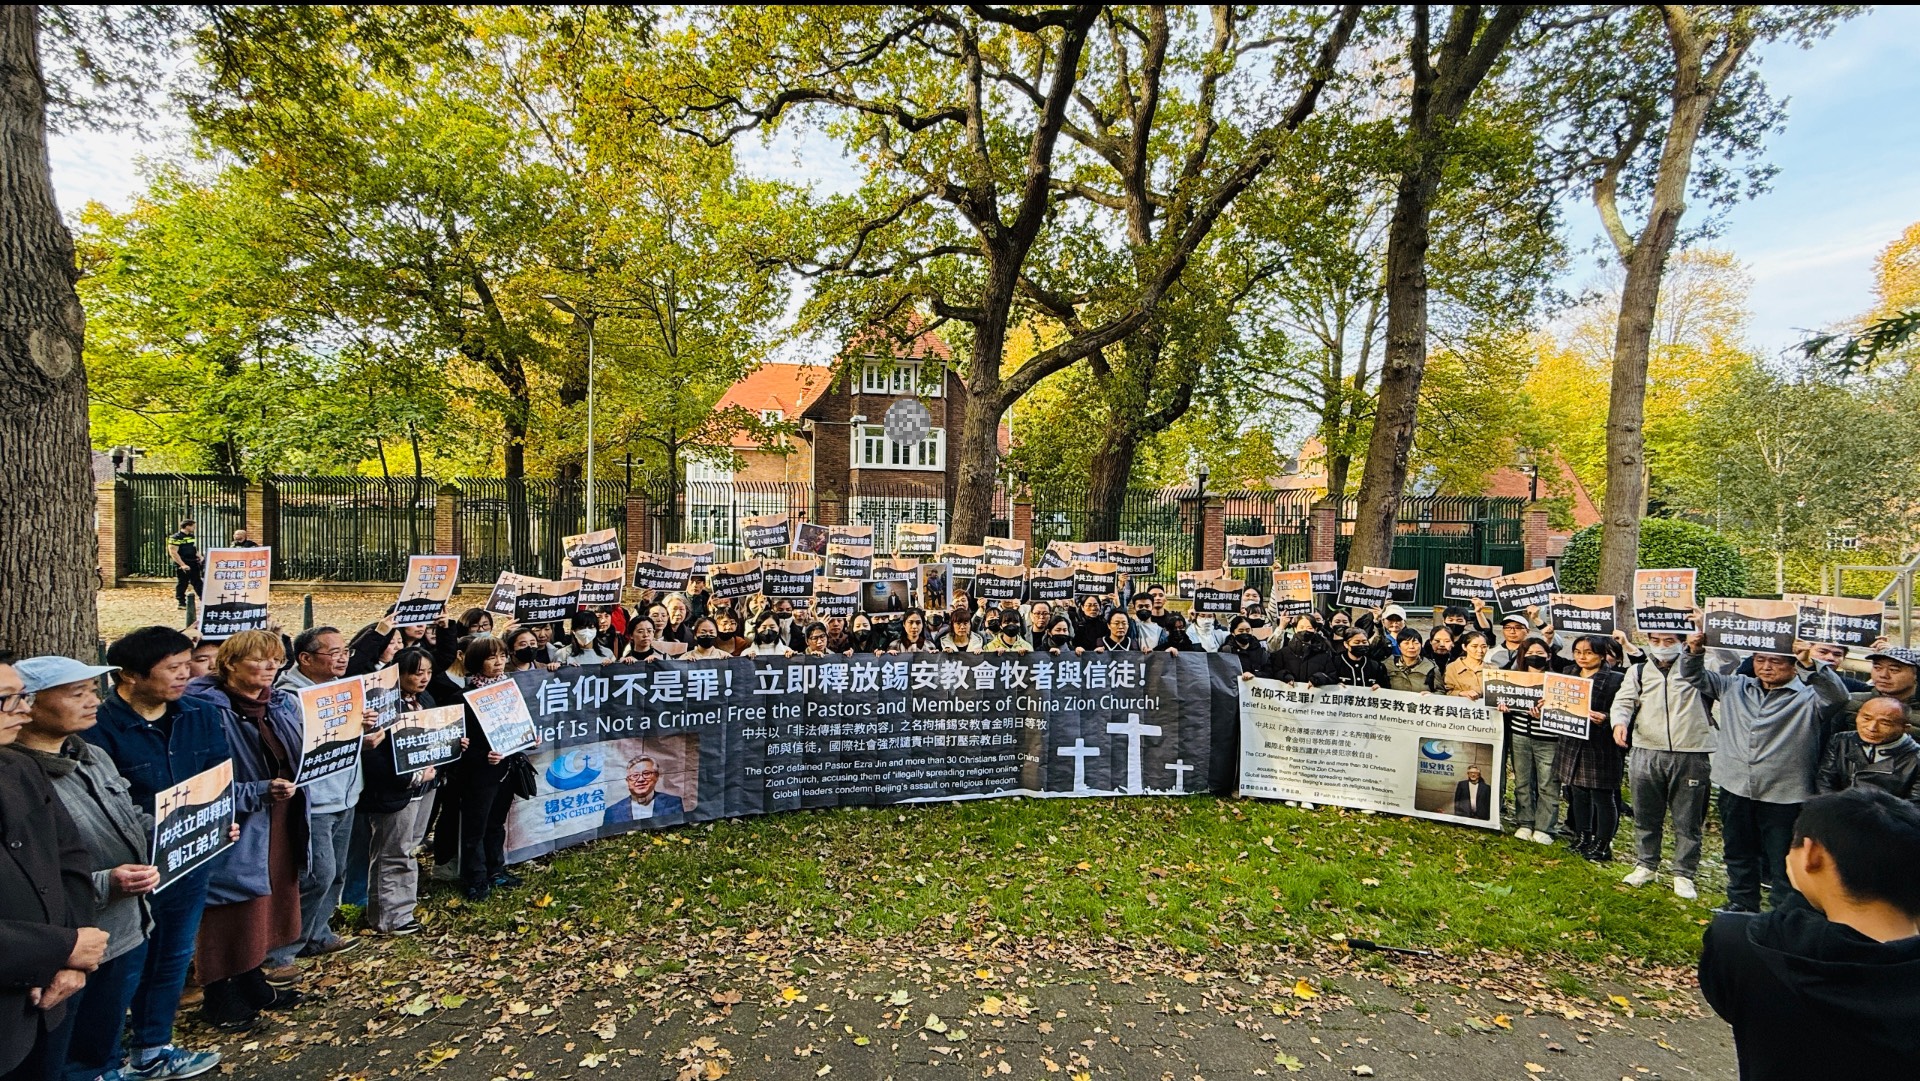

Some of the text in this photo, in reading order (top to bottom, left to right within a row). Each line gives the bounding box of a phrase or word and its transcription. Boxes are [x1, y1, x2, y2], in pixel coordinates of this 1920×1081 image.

[744, 526, 787, 537] 中共立即釋放
[569, 542, 617, 558] 中共立即釋放
[986, 548, 1022, 558] 中共立即釋放
[1229, 548, 1272, 556] 中共立即釋放
[829, 557, 870, 567] 中共立即釋放
[1110, 555, 1152, 564] 中共立即釋放
[639, 567, 689, 579] 中共立即釋放
[713, 572, 760, 587] 中共立即釋放
[765, 574, 812, 583] 中共立即釋放
[978, 578, 1021, 587] 中共立即釋放
[1033, 580, 1073, 589] 中共立即釋放
[772, 586, 804, 594] 王林牧師
[1197, 592, 1240, 600] 中共立即釋放
[1343, 585, 1386, 597] 中共立即釋放
[1499, 582, 1555, 599] 中共立即釋放
[519, 596, 576, 608] 中共立即釋放
[206, 608, 266, 620] 中共立即釋放
[1554, 609, 1611, 620] 中共立即釋放
[1708, 617, 1792, 634] 中共立即釋放
[1800, 613, 1878, 630] 共立即釋放
[1720, 633, 1776, 649] 戰歌傳道
[1487, 684, 1543, 698] 中共立即釋放
[570, 721, 588, 737] Is
[596, 716, 633, 734] Not
[640, 716, 651, 730] a
[658, 708, 721, 729] Crime!
[728, 705, 766, 722] Free
[772, 702, 800, 719] the
[807, 701, 871, 717] Pastors
[876, 697, 906, 714] and
[912, 696, 990, 713] Members
[996, 696, 1012, 711] of
[1016, 696, 1060, 712] China
[1064, 696, 1096, 711] Zion
[1100, 694, 1160, 710] Church!
[1242, 701, 1259, 709] Belief
[1269, 704, 1280, 712] Not
[1364, 712, 1377, 720] and
[1380, 715, 1414, 725] Members
[1426, 721, 1447, 729] China
[1449, 723, 1465, 731] Zion
[1467, 725, 1496, 734] Church!
[1544, 712, 1586, 726] 中共立即釋放
[396, 726, 464, 750] 中共立即釋放
[304, 742, 358, 767] 中共立即釋放
[408, 745, 452, 765] 戰歌傳道
[745, 767, 761, 775] The
[764, 765, 784, 775] CCP
[787, 763, 822, 772] detained
[825, 762, 852, 770] Pastor
[889, 758, 903, 767] and
[959, 755, 996, 763] Christians
[1018, 753, 1040, 762] China
[766, 779, 784, 787] Zion
[787, 775, 819, 784] Church,
[822, 774, 858, 782] accusing
[926, 769, 964, 777] spreading
[967, 767, 994, 776] religion
[773, 789, 800, 799] Global
[802, 787, 833, 795] leaders
[835, 786, 872, 794] condemn
[875, 783, 907, 793] Beijing's
[910, 781, 938, 790] assault
[952, 780, 983, 789] religious
[985, 777, 1018, 786] freedom.
[545, 803, 606, 824] ZION CHURCH
[160, 796, 232, 848] 中共立即釋放
[167, 828, 220, 872] 劉江弟兄
